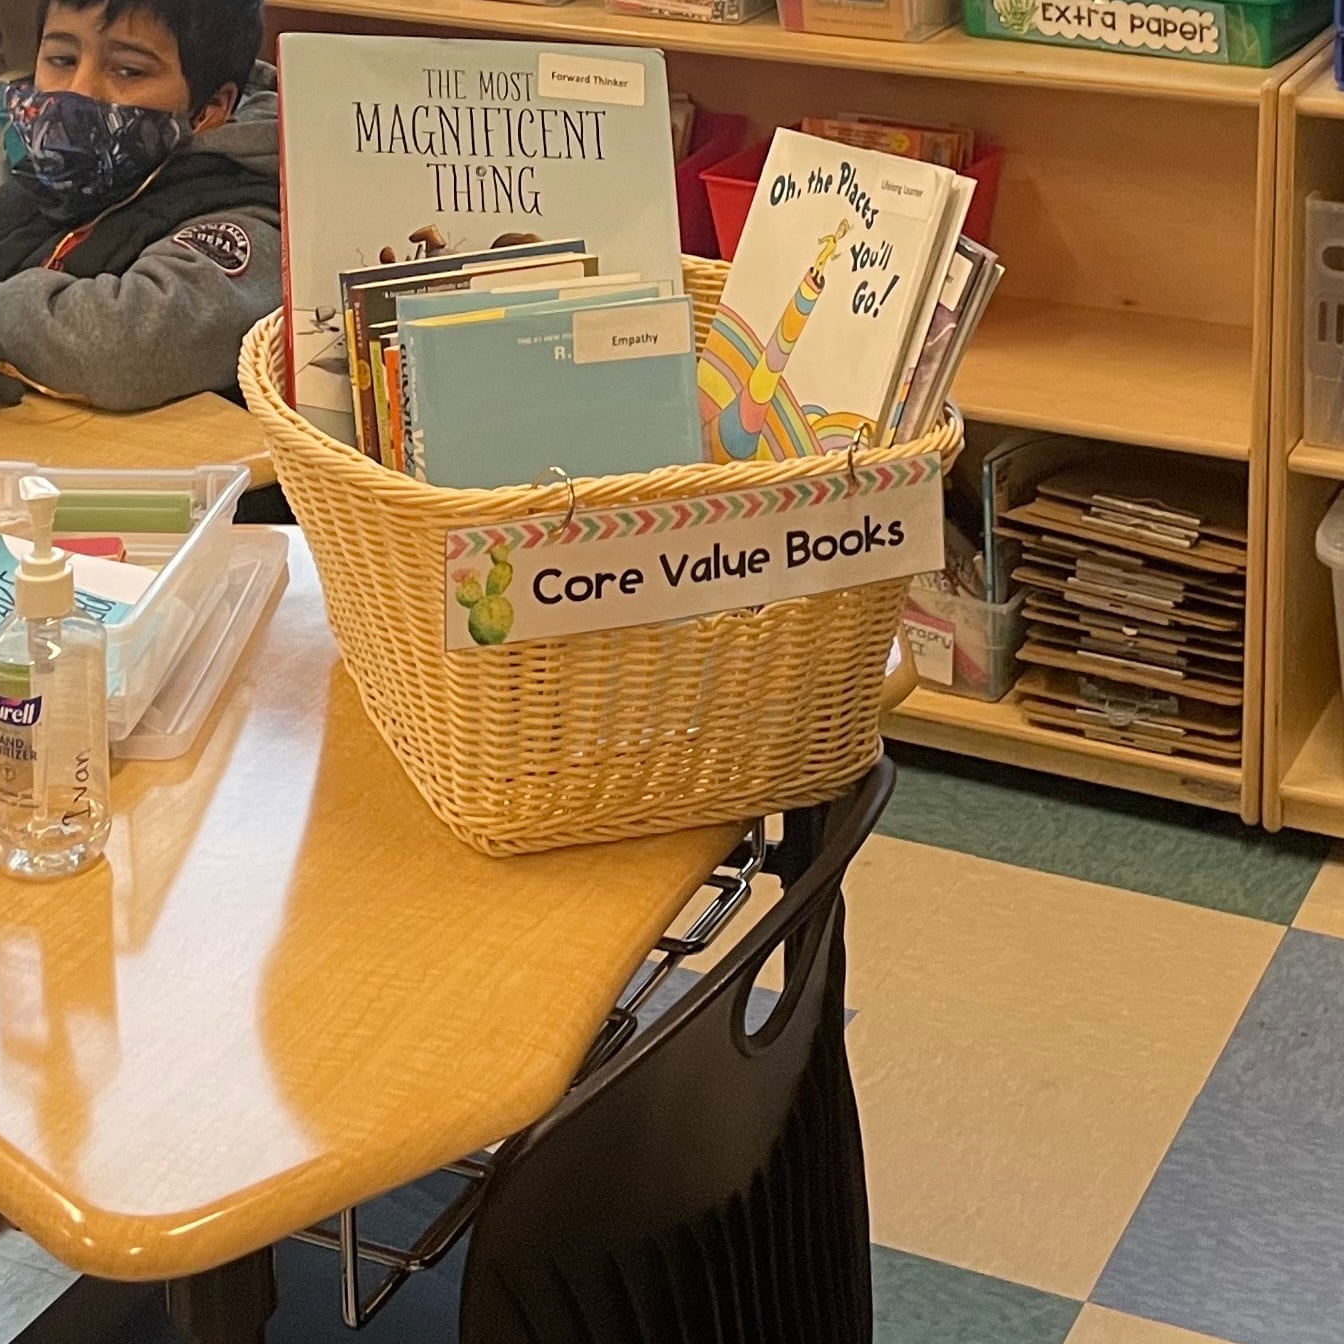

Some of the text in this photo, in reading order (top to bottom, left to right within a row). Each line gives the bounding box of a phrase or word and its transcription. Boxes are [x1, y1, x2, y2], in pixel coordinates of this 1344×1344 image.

[1041, 1, 1213, 45] Extra paper
[422, 68, 535, 102] THE MOST
[551, 71, 630, 88] Forward Thinker
[352, 101, 607, 161] MAGNIFICENT
[769, 160, 880, 230] Oh, the Places
[849, 240, 894, 273] You'll
[852, 274, 901, 319] Go!
[611, 332, 659, 348] Empathy
[532, 514, 906, 605] Core Value Books
